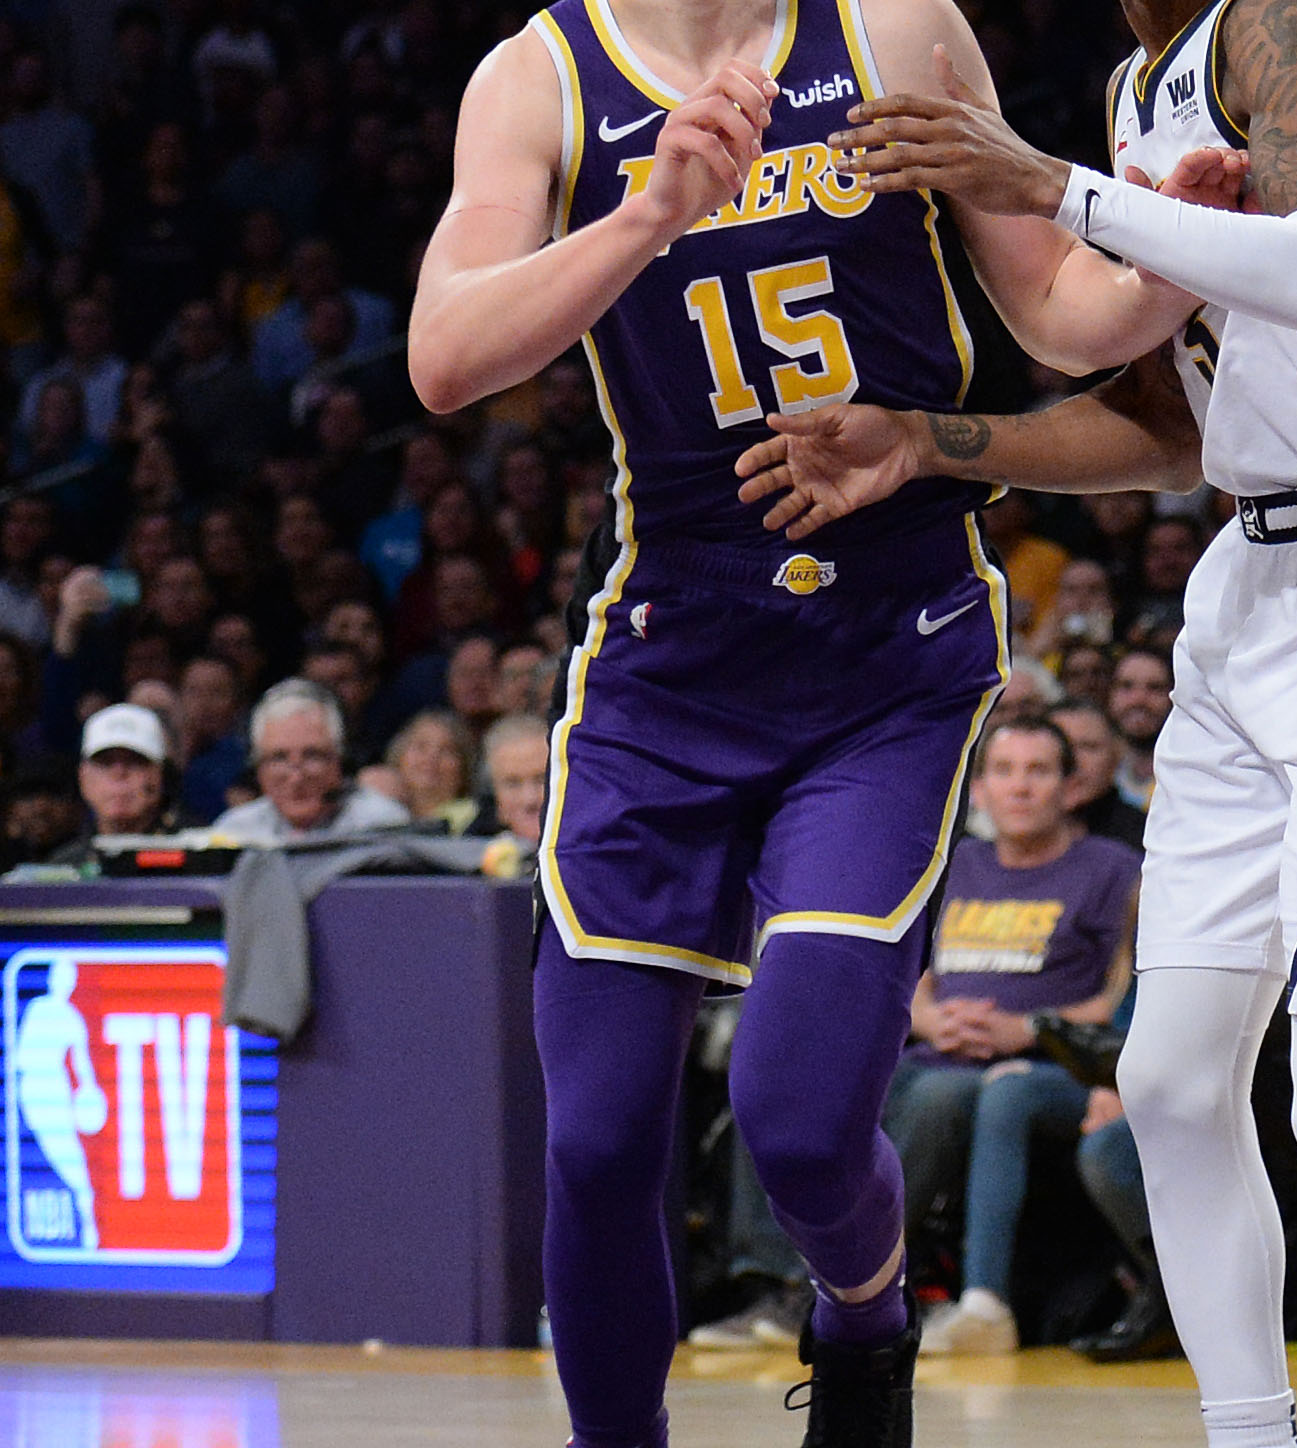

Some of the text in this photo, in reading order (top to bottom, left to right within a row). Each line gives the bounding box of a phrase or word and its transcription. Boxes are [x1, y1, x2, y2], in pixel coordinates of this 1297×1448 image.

[781, 73, 855, 109] wish
[1166, 68, 1196, 109] WU
[683, 255, 860, 430] 15
[103, 1012, 212, 1201] TV
